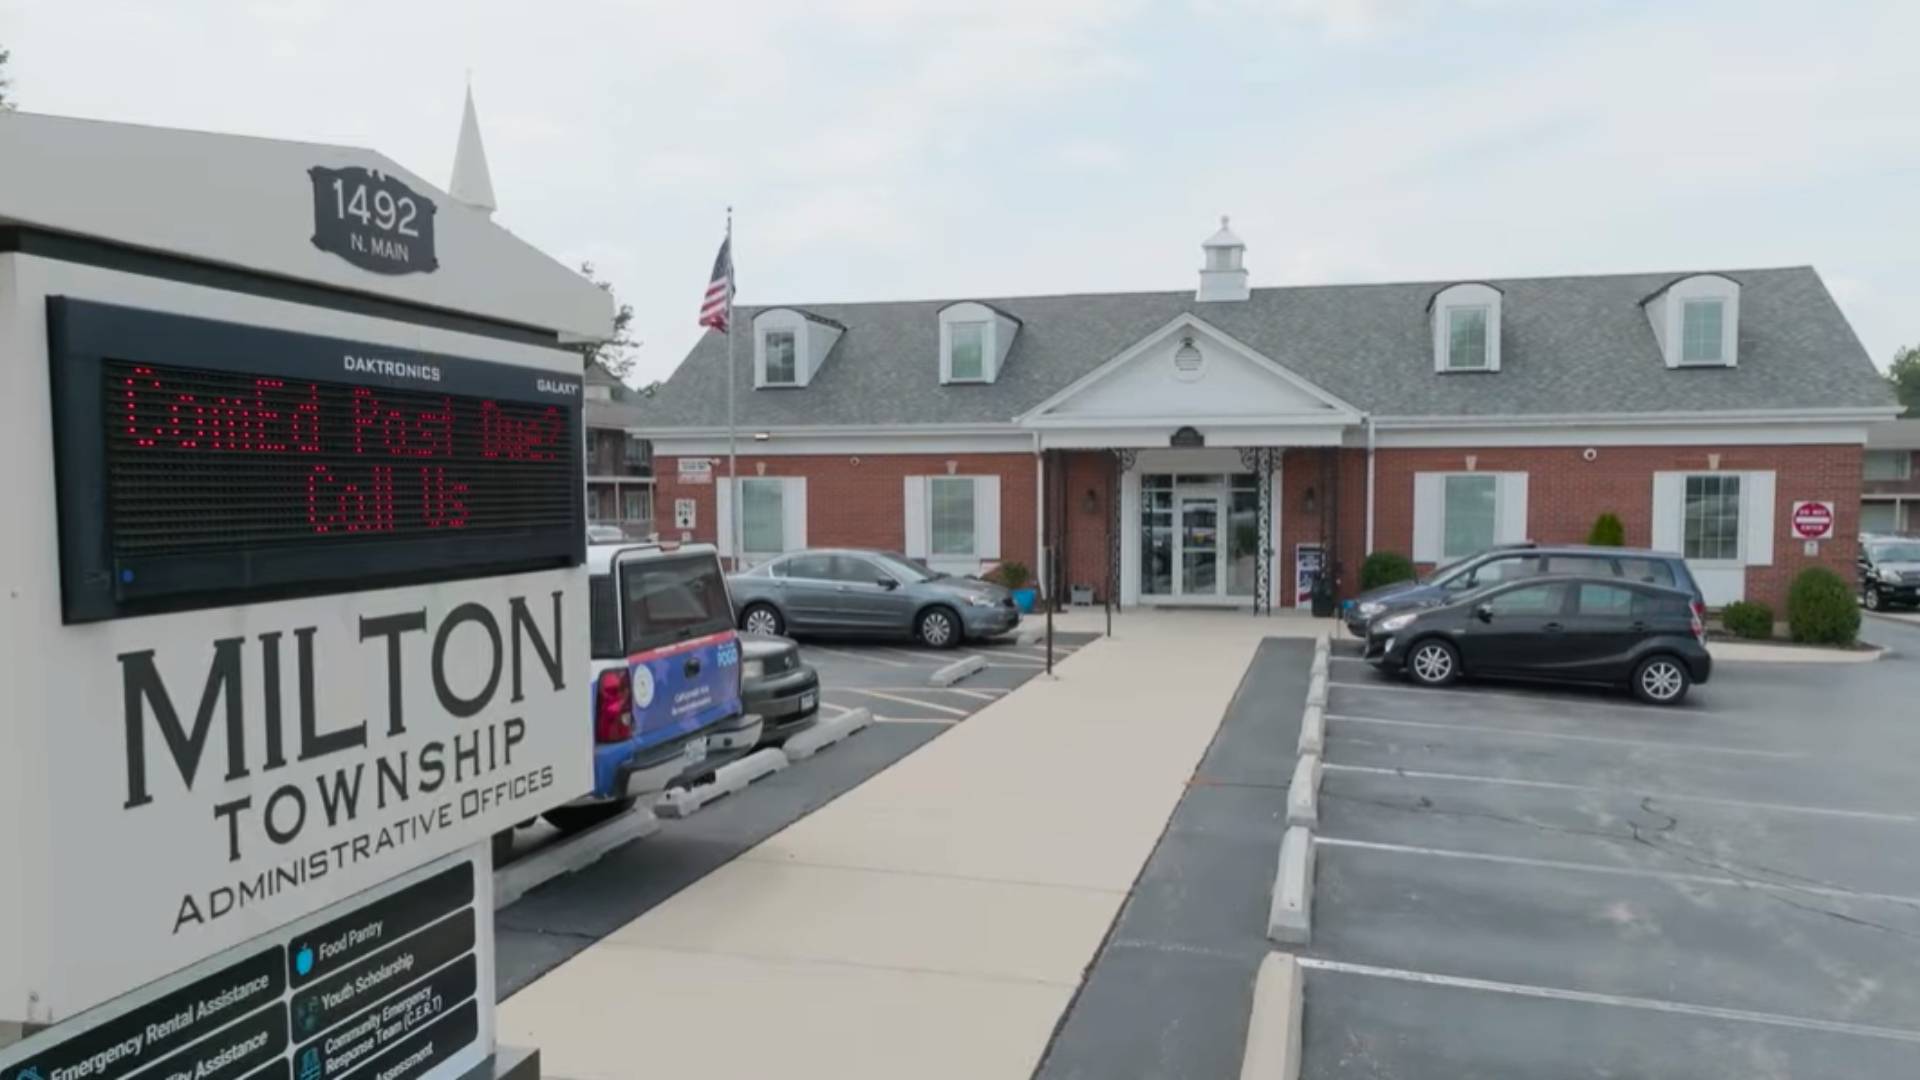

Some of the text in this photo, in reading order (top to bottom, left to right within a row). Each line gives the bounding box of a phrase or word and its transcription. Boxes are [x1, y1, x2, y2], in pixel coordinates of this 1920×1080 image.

[333, 178, 418, 237] 1492
[350, 232, 409, 262] N. MAIN
[343, 355, 441, 381] DAKTRONICS
[125, 367, 319, 451] ComEd
[354, 388, 453, 457] Past
[308, 465, 470, 533] Call Us
[117, 591, 565, 809] MILTON
[214, 717, 526, 862] TOWNSHIP
[172, 765, 553, 934] ADMINISTRATIVE OFFICES
[319, 920, 383, 961] Food Pantry
[322, 953, 414, 1010] Youth Scholarship
[50, 974, 269, 1080] Emergency Rental Assistance
[325, 985, 433, 1054] Community Emergency
[326, 1036, 374, 1075] Response
[376, 1021, 403, 1044] Team
[194, 1030, 269, 1080] Assistance
